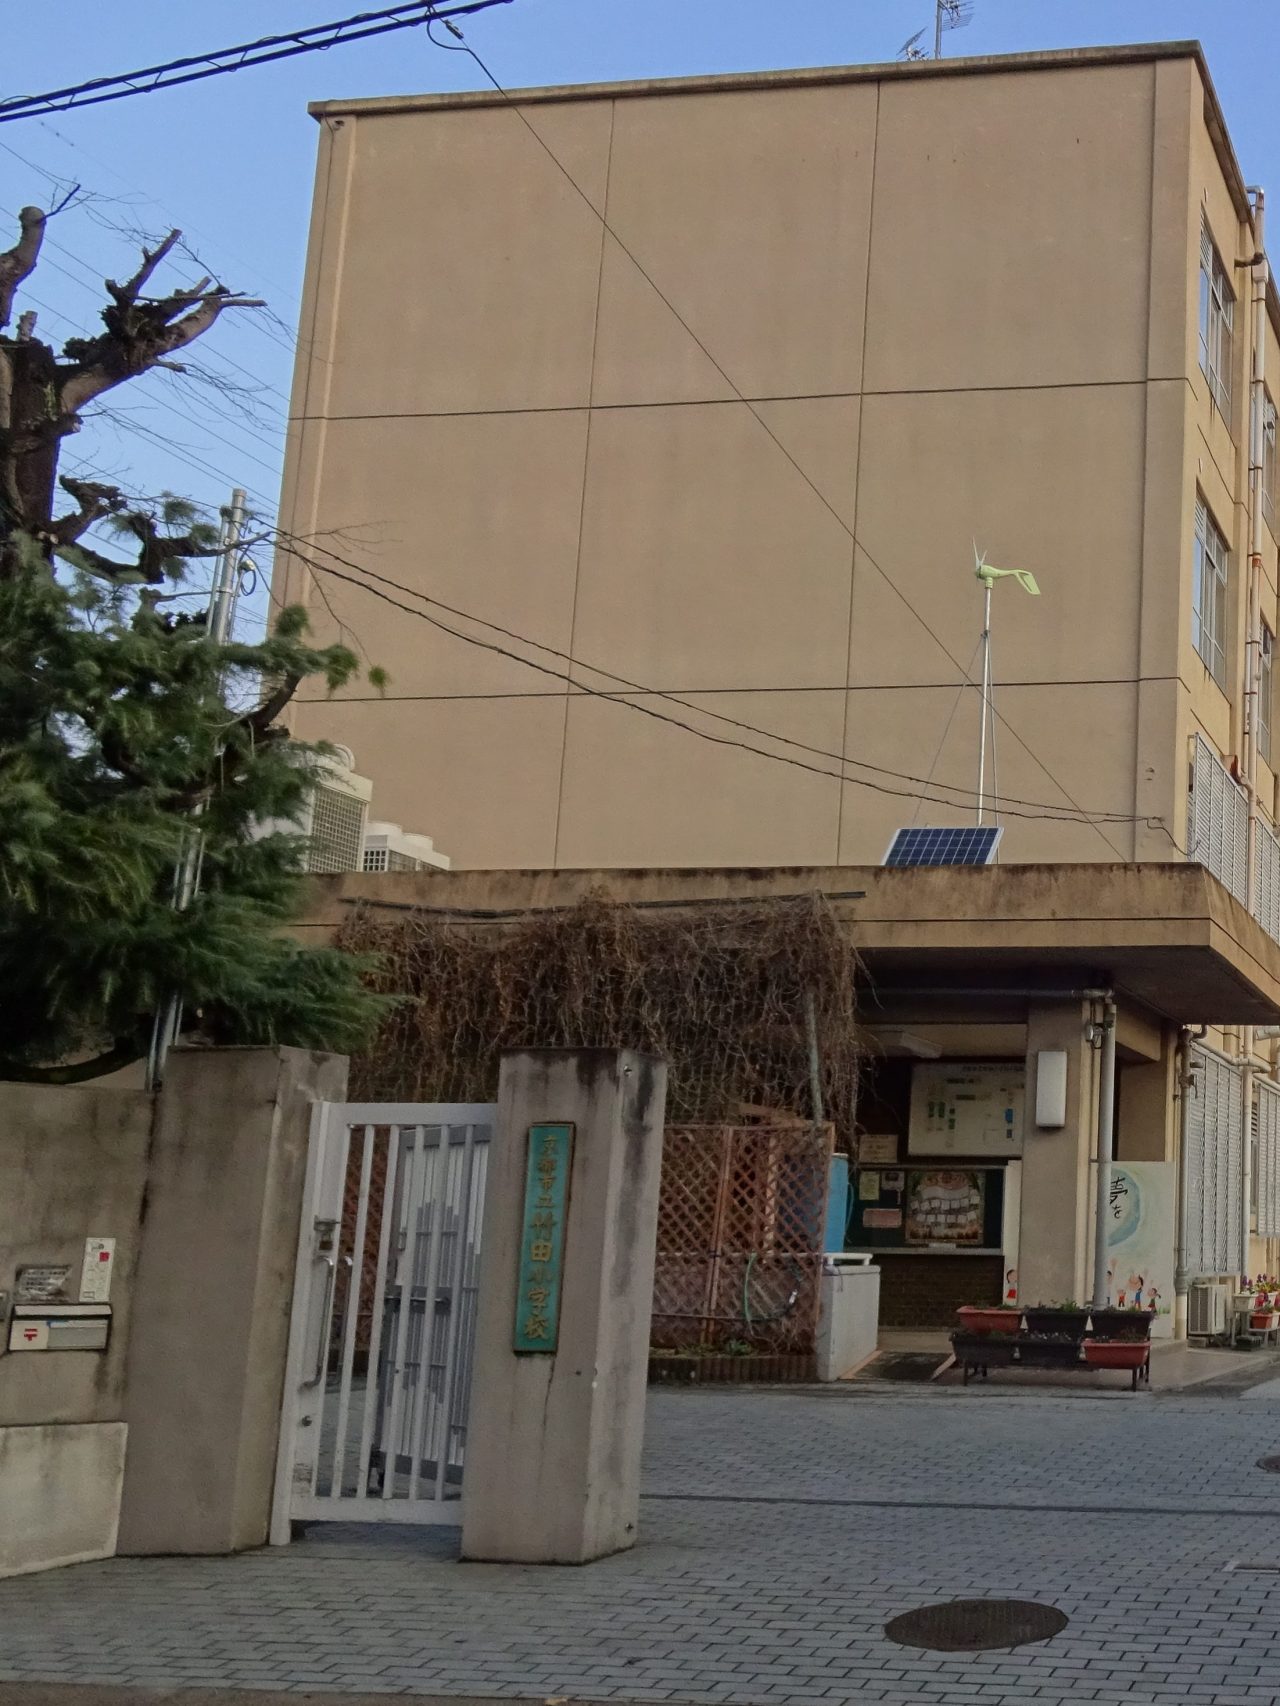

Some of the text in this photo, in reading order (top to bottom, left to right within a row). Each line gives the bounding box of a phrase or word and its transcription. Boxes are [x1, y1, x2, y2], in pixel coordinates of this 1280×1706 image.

[523, 1135, 558, 1341] 京都市立竹田小学校
